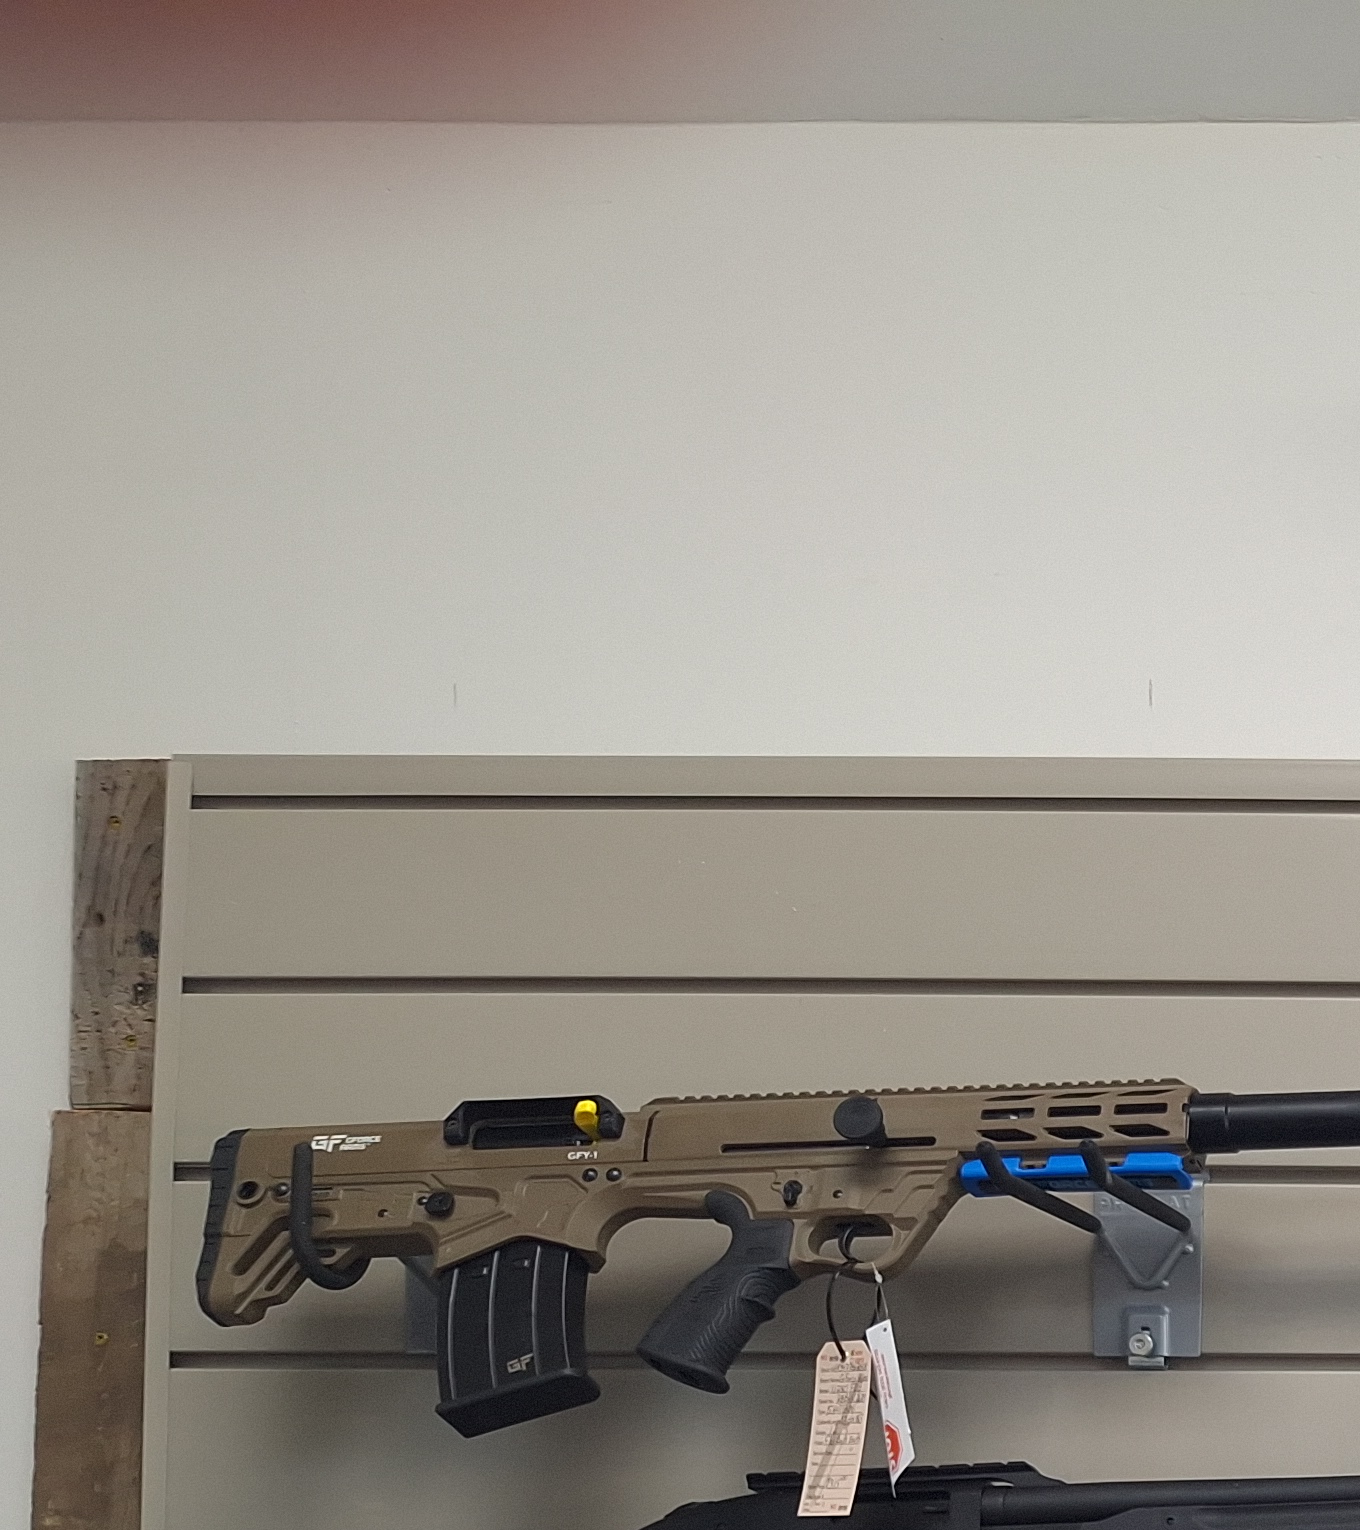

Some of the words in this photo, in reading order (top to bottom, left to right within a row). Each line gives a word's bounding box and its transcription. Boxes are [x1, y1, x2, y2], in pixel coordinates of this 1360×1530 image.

[311, 1135, 347, 1152] GF
[567, 1151, 598, 1160] GFY-1
[507, 1353, 534, 1374] GF
